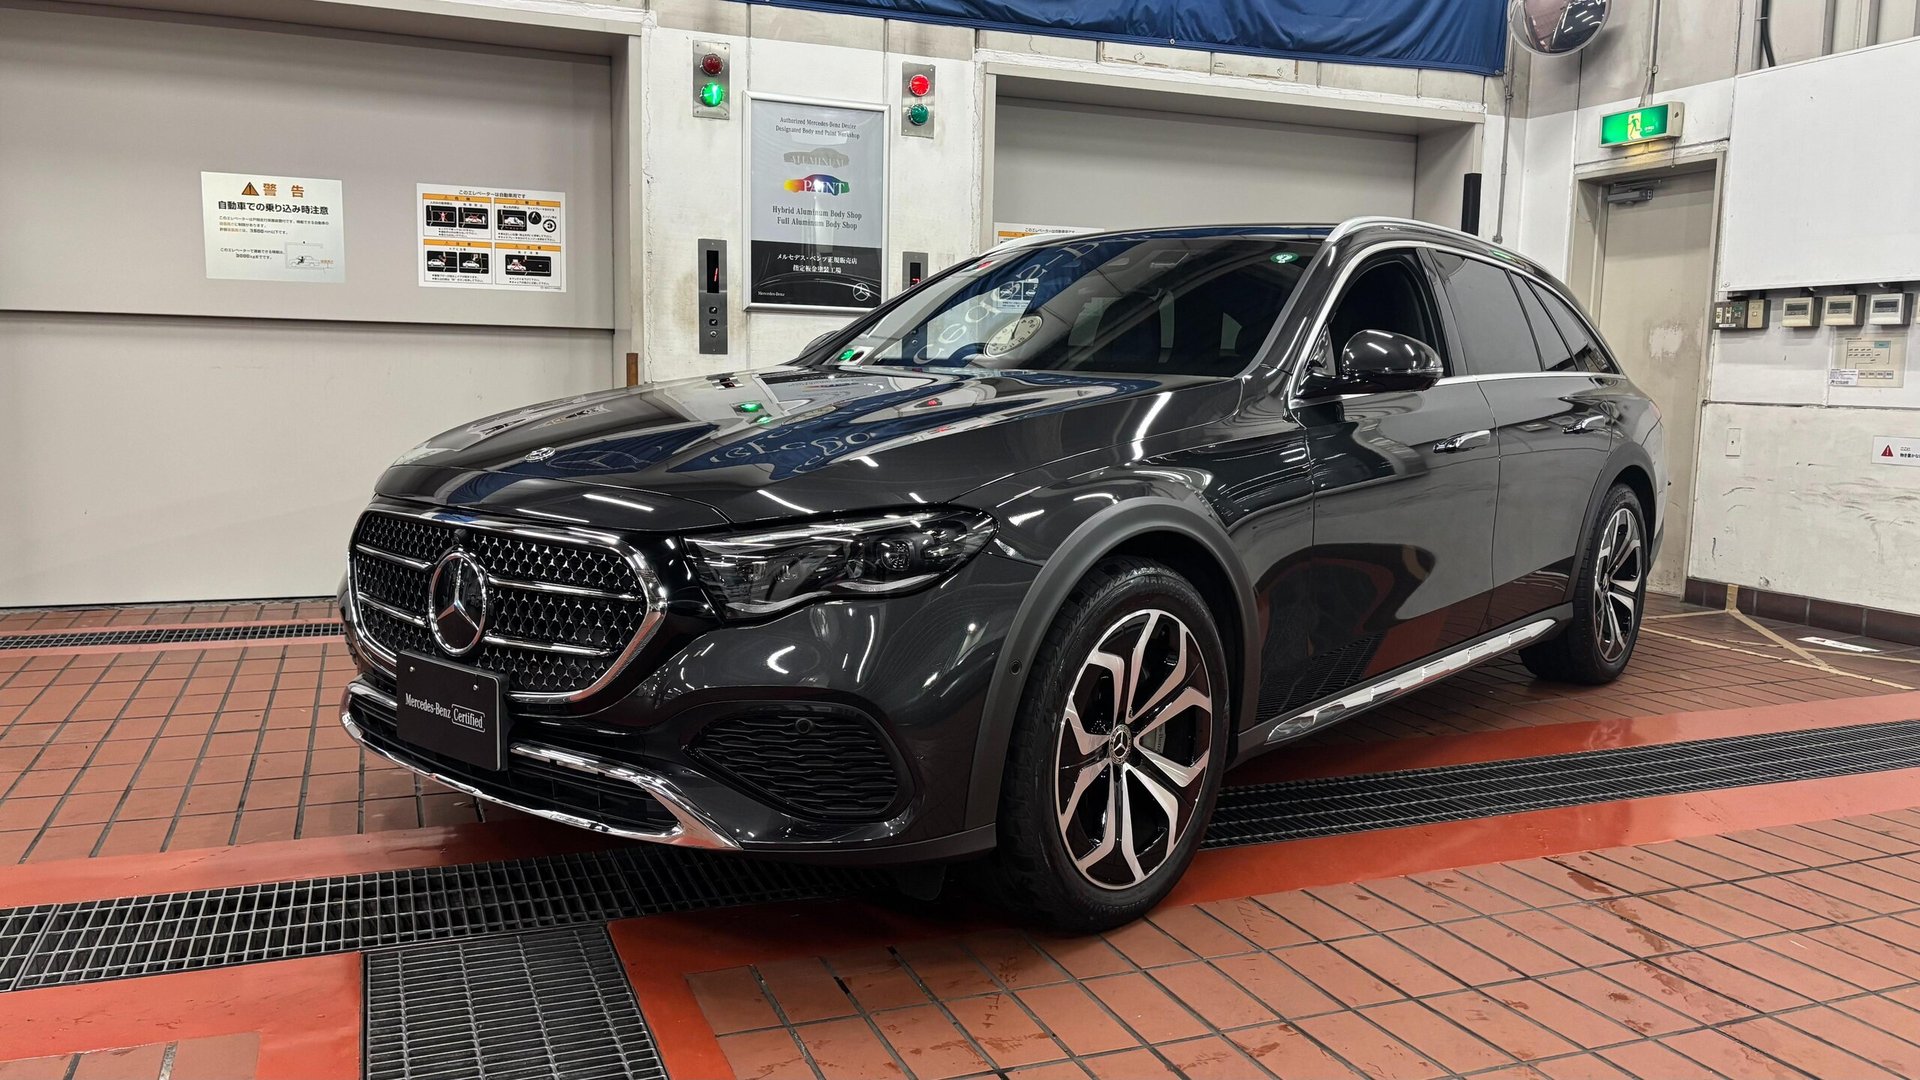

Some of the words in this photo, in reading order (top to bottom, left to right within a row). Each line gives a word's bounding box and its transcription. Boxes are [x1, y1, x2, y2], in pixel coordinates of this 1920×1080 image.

[776, 125, 801, 133] Designated
[806, 119, 841, 129] Mercedes-Benz
[792, 155, 845, 167] ALUMINUM
[803, 180, 845, 195] PAINT
[218, 200, 329, 216] 自動車での乗り込み時注意
[772, 205, 795, 215] Hybrid
[796, 207, 829, 217] Aluminum
[830, 209, 846, 219] Body
[847, 211, 862, 221] Shop
[777, 216, 790, 225] Full
[791, 218, 825, 227] Aluminum
[825, 220, 841, 229] Body
[842, 222, 857, 230] Shop
[405, 692, 452, 719] Mercedes-Benz
[453, 708, 484, 729] Certified
